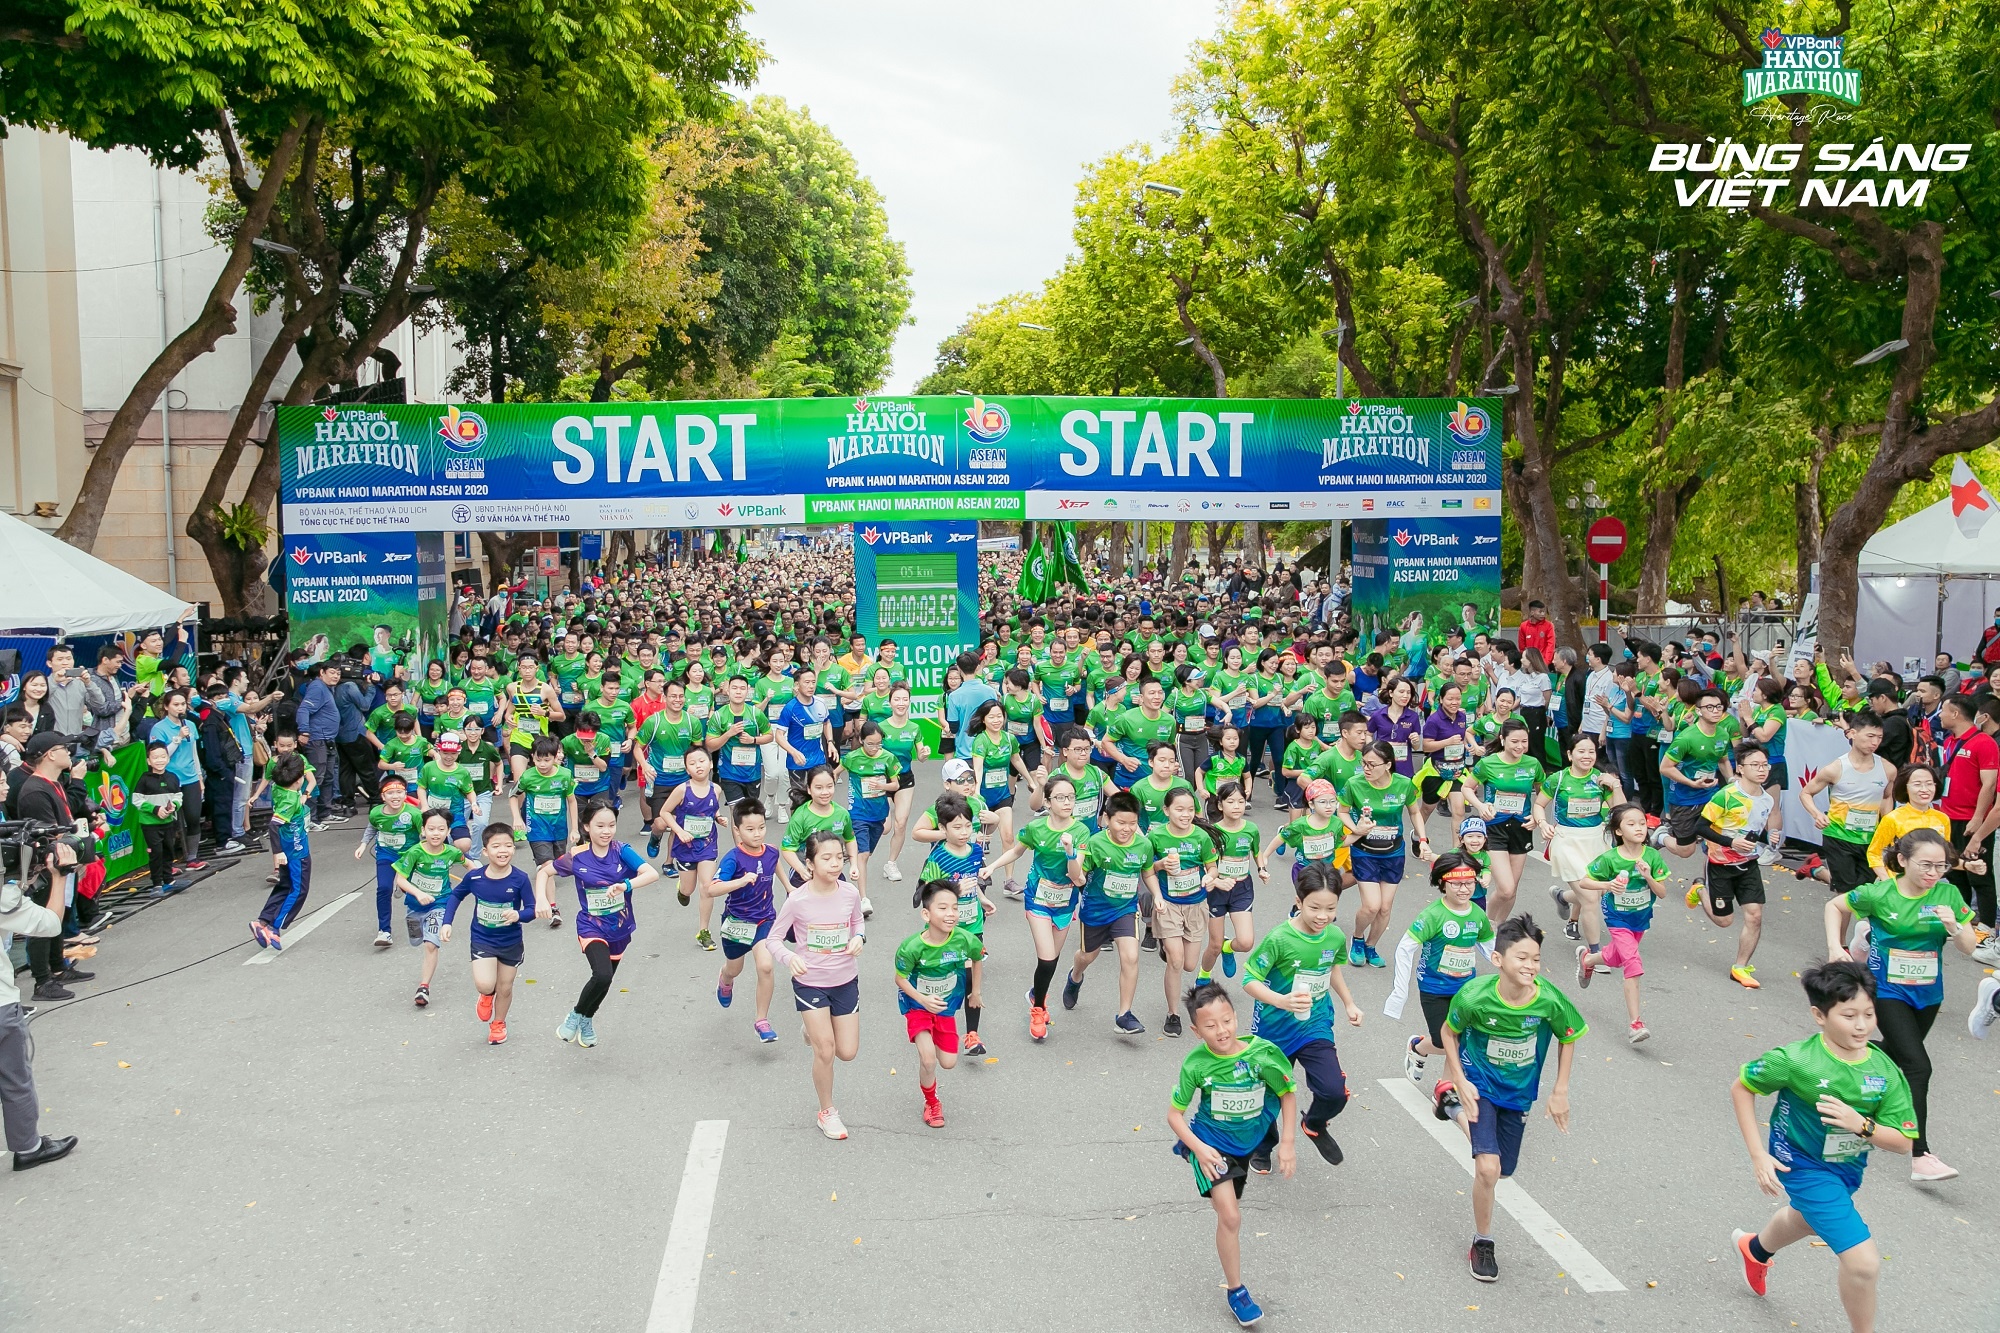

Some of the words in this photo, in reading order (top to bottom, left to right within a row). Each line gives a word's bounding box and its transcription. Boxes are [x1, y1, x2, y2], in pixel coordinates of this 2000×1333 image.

[873, 401, 915, 412] VPBank
[1364, 405, 1404, 415] VPBank
[342, 410, 387, 421] VPBank
[846, 412, 927, 432] HANOI
[1340, 416, 1413, 434] HANOI
[315, 421, 399, 442] HANOI
[551, 413, 757, 484] START
[1060, 410, 1254, 477] START
[827, 434, 945, 470] MARATHON
[970, 449, 1006, 461] ASEAN
[1321, 437, 1430, 470] MARATHON
[1453, 451, 1485, 463] ASEAN
[296, 443, 419, 479] MARATHON
[446, 458, 484, 471] ASEAN
[826, 477, 864, 488] VPBANK
[867, 476, 896, 486] HANOI
[899, 475, 951, 486] MARATHON
[953, 474, 984, 485] ASEAN
[987, 474, 1010, 485] 2020
[1318, 475, 1354, 485] VPBANK
[1356, 474, 1383, 485] HANOI
[1385, 474, 1434, 484] MARATHON
[1436, 474, 1464, 484] ASEAN
[1466, 473, 1487, 484] 2020
[295, 488, 336, 498] VPBANK
[338, 487, 369, 497] HANOI
[372, 486, 429, 496] MARATHON
[430, 485, 463, 496] ASEAN
[465, 485, 488, 495] 2020
[475, 505, 495, 513] UBND
[497, 504, 522, 513] THÀNH
[542, 504, 552, 512] HÀ
[738, 504, 787, 517] VPBank
[812, 500, 855, 513] VPBANK
[858, 499, 891, 511] HANOI
[894, 498, 954, 510] MARATHON
[956, 497, 992, 509] ASEAN
[994, 497, 1020, 509] 2020
[1056, 500, 1090, 509] XTEP
[311, 507, 327, 516] VĂN
[364, 507, 385, 515] THAO
[386, 506, 397, 515] VÀ
[487, 514, 503, 523] VĂN
[504, 514, 521, 522] HÓA
[522, 514, 533, 522] VÀ
[550, 514, 570, 522] THAO
[882, 531, 933, 544] VPBank
[1413, 534, 1460, 546] VPBank
[314, 551, 368, 564] VPBank
[1393, 558, 1425, 568] VPBANK
[1427, 557, 1451, 566] HANOI
[1454, 556, 1498, 566] MARATHON
[900, 565, 913, 578] 05
[917, 565, 934, 578] km
[1393, 570, 1430, 583] ASEAN
[1432, 569, 1459, 581] 2020
[292, 577, 328, 587] VPBANK
[331, 575, 360, 586] HANOI
[362, 574, 413, 585] MARATHON
[293, 590, 334, 603] ASEAN
[338, 589, 368, 602] 2020
[1499, 799, 1518, 808] 52323
[1226, 866, 1244, 874] 50071
[417, 879, 436, 890] 51532
[1111, 881, 1131, 890] 50851
[1174, 878, 1195, 889] 52500
[1044, 890, 1063, 901] 52192
[1621, 895, 1645, 905] 52425
[727, 926, 748, 936] 52212
[816, 935, 840, 944] 50390
[1449, 957, 1471, 967] 51084
[1899, 964, 1927, 974] 51267
[925, 983, 949, 993] 51802
[1498, 1047, 1529, 1058] 50857
[1222, 1098, 1255, 1111] 52372
